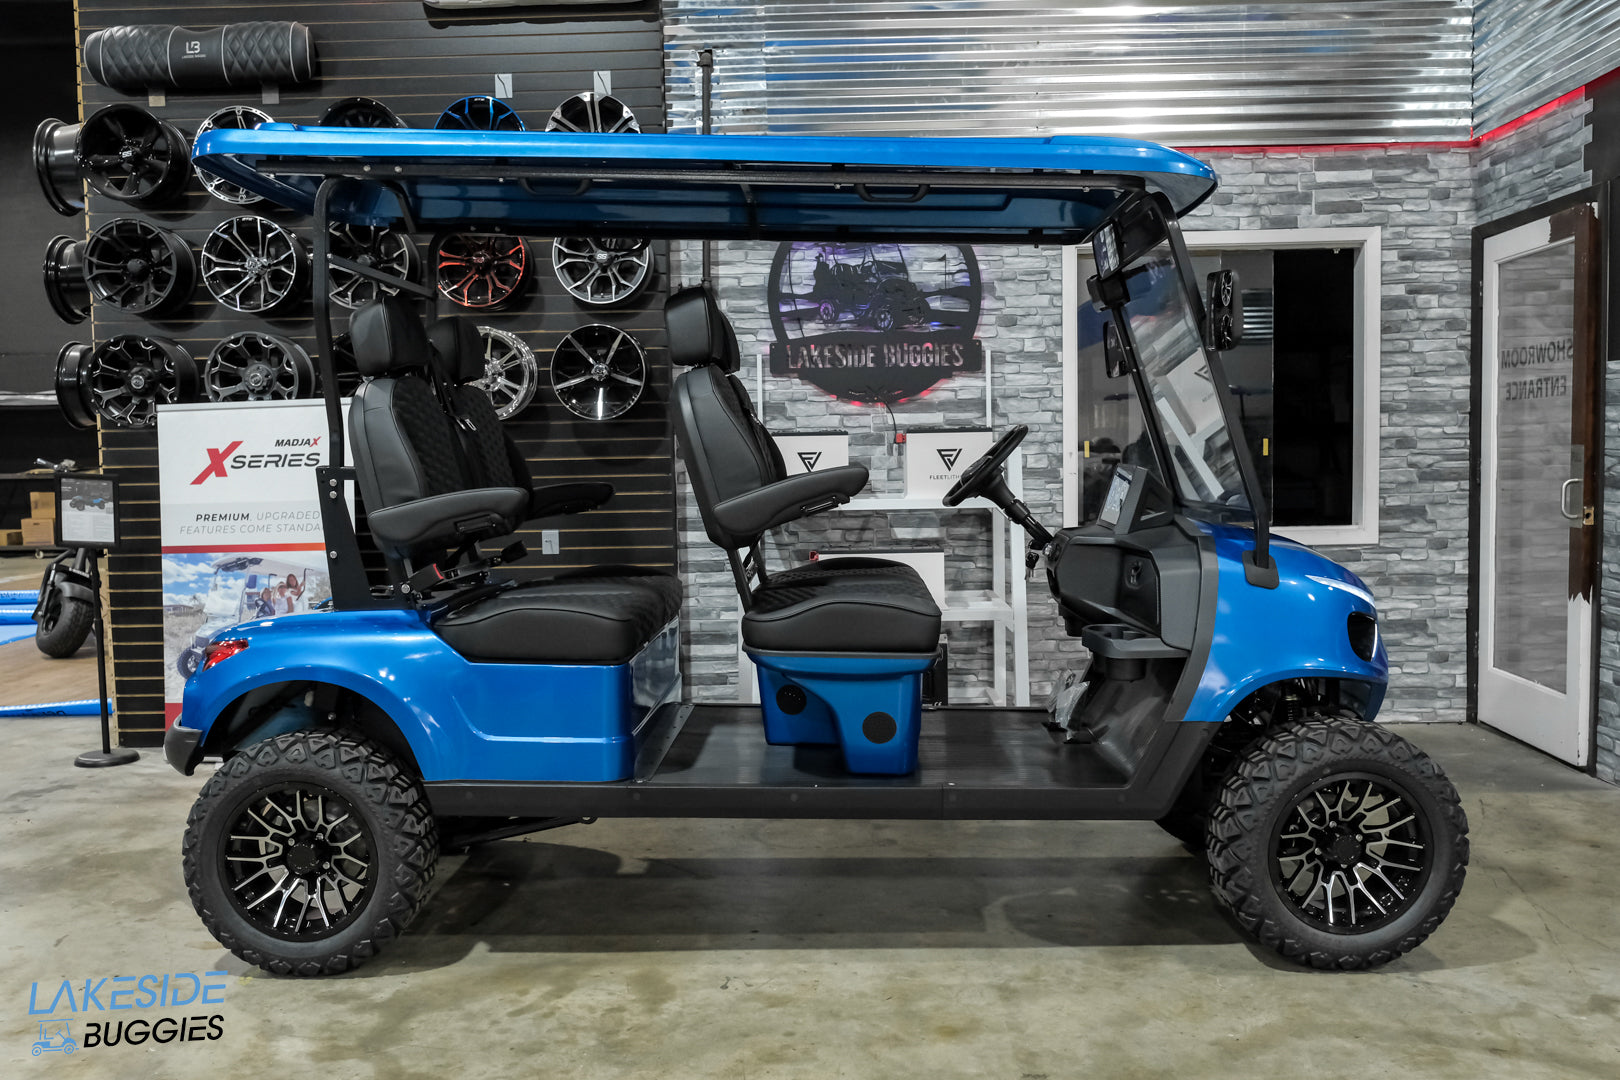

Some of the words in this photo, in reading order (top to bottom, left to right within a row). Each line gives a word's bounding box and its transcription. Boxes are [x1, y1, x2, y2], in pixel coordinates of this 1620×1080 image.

[786, 344, 877, 369] LAKESIDE
[883, 342, 964, 367] BUGGIES
[274, 436, 322, 447] MADJAX
[256, 510, 321, 520] UPGRADED
[179, 525, 237, 535] FEATURES
[239, 525, 273, 533] COME
[276, 523, 321, 533] STANDA
